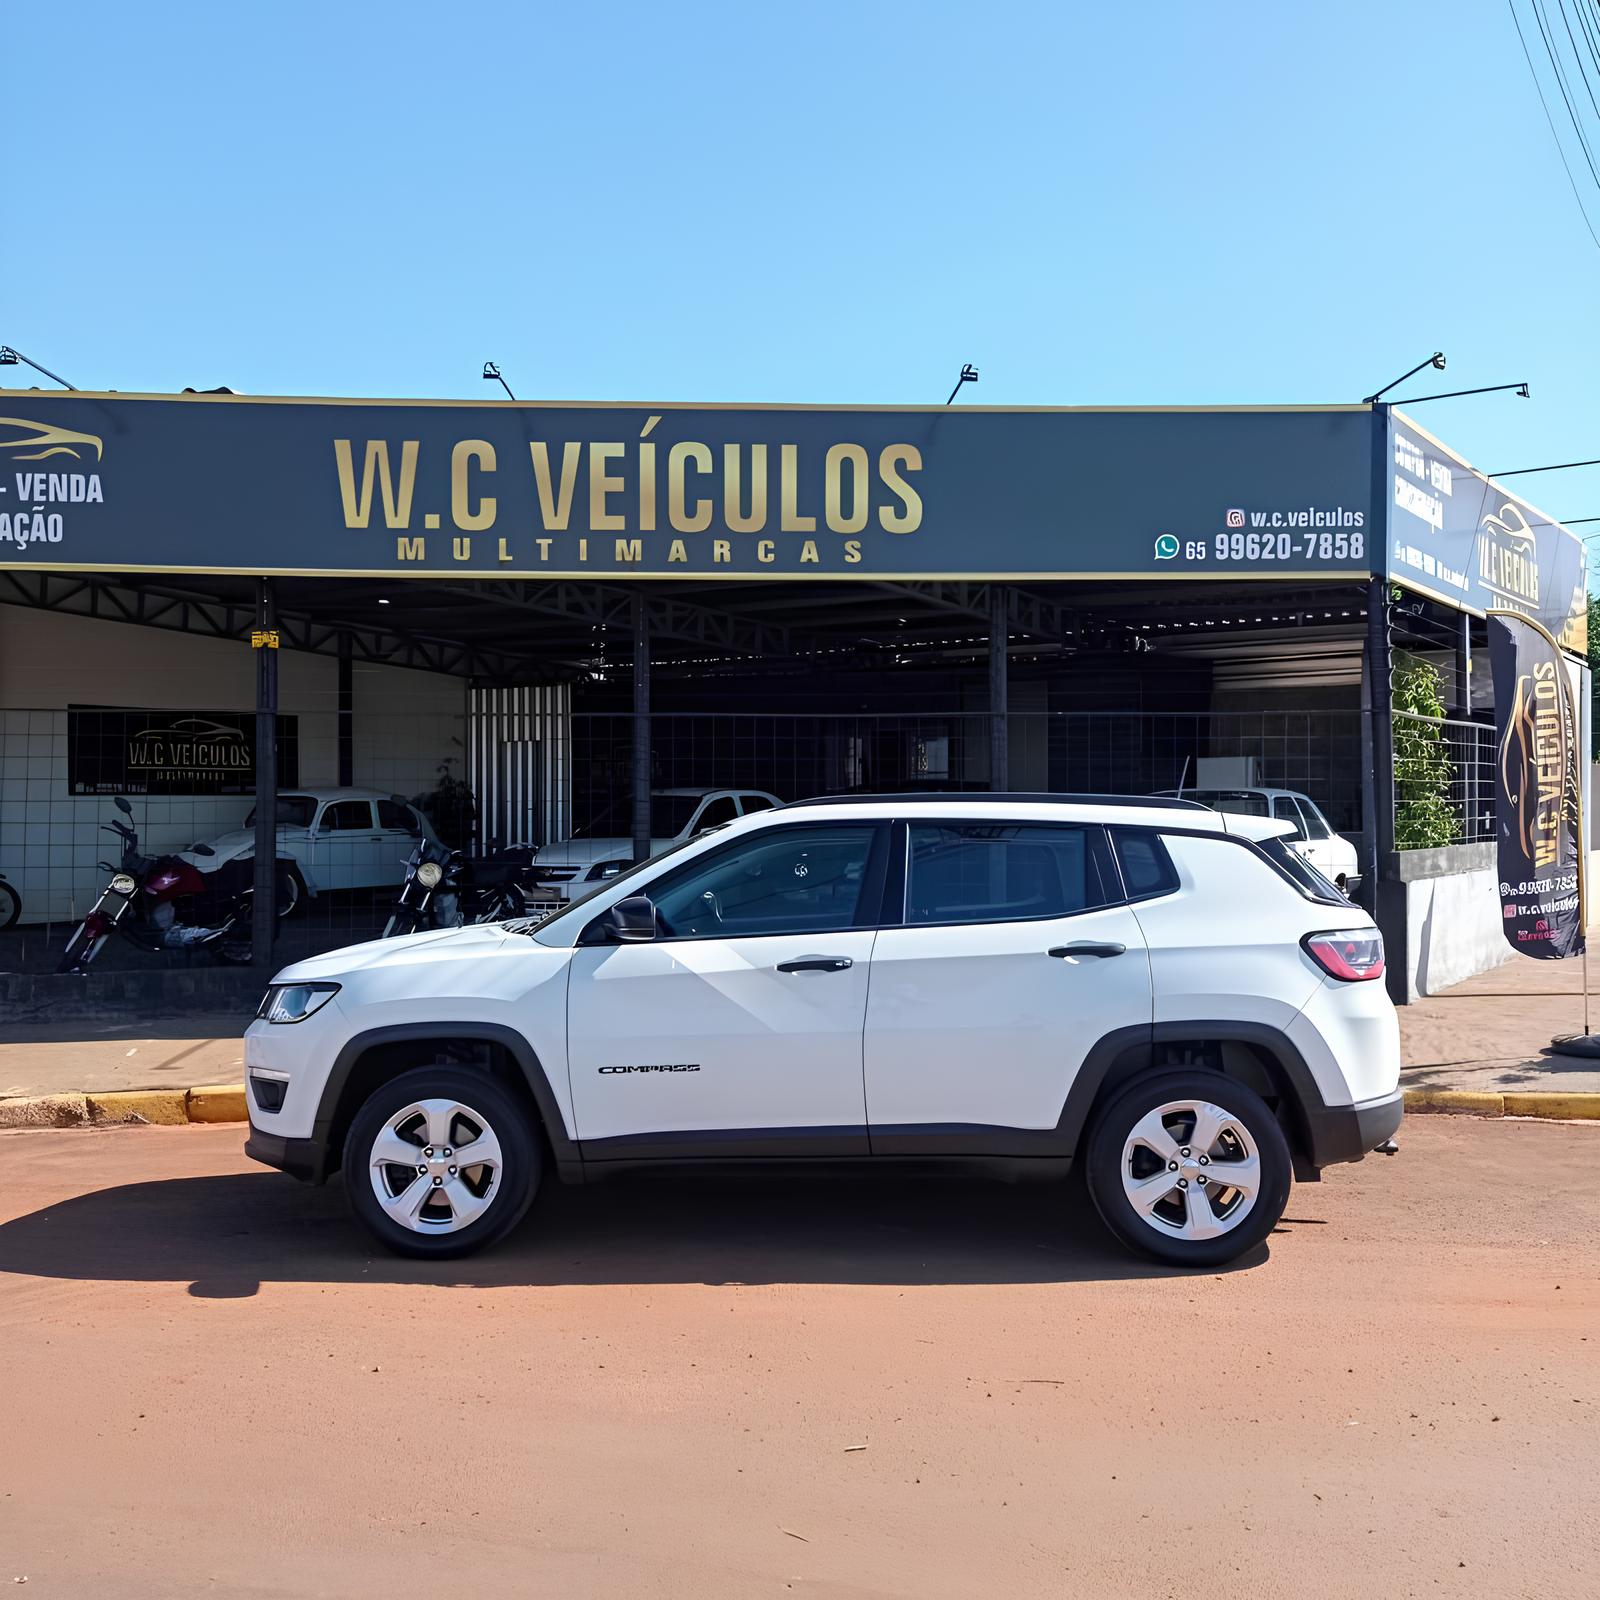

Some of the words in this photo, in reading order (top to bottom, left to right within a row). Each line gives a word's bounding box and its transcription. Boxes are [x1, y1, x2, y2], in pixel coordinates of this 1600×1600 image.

[15, 472, 104, 503] VENDA
[334, 439, 497, 531] W.C
[529, 416, 923, 534] VEÍCULOS
[397, 537, 862, 564] MULTIMARCAS
[1185, 541, 1206, 560] 65
[1215, 533, 1365, 560] 99620-7858
[598, 1064, 701, 1075] COMPASS
